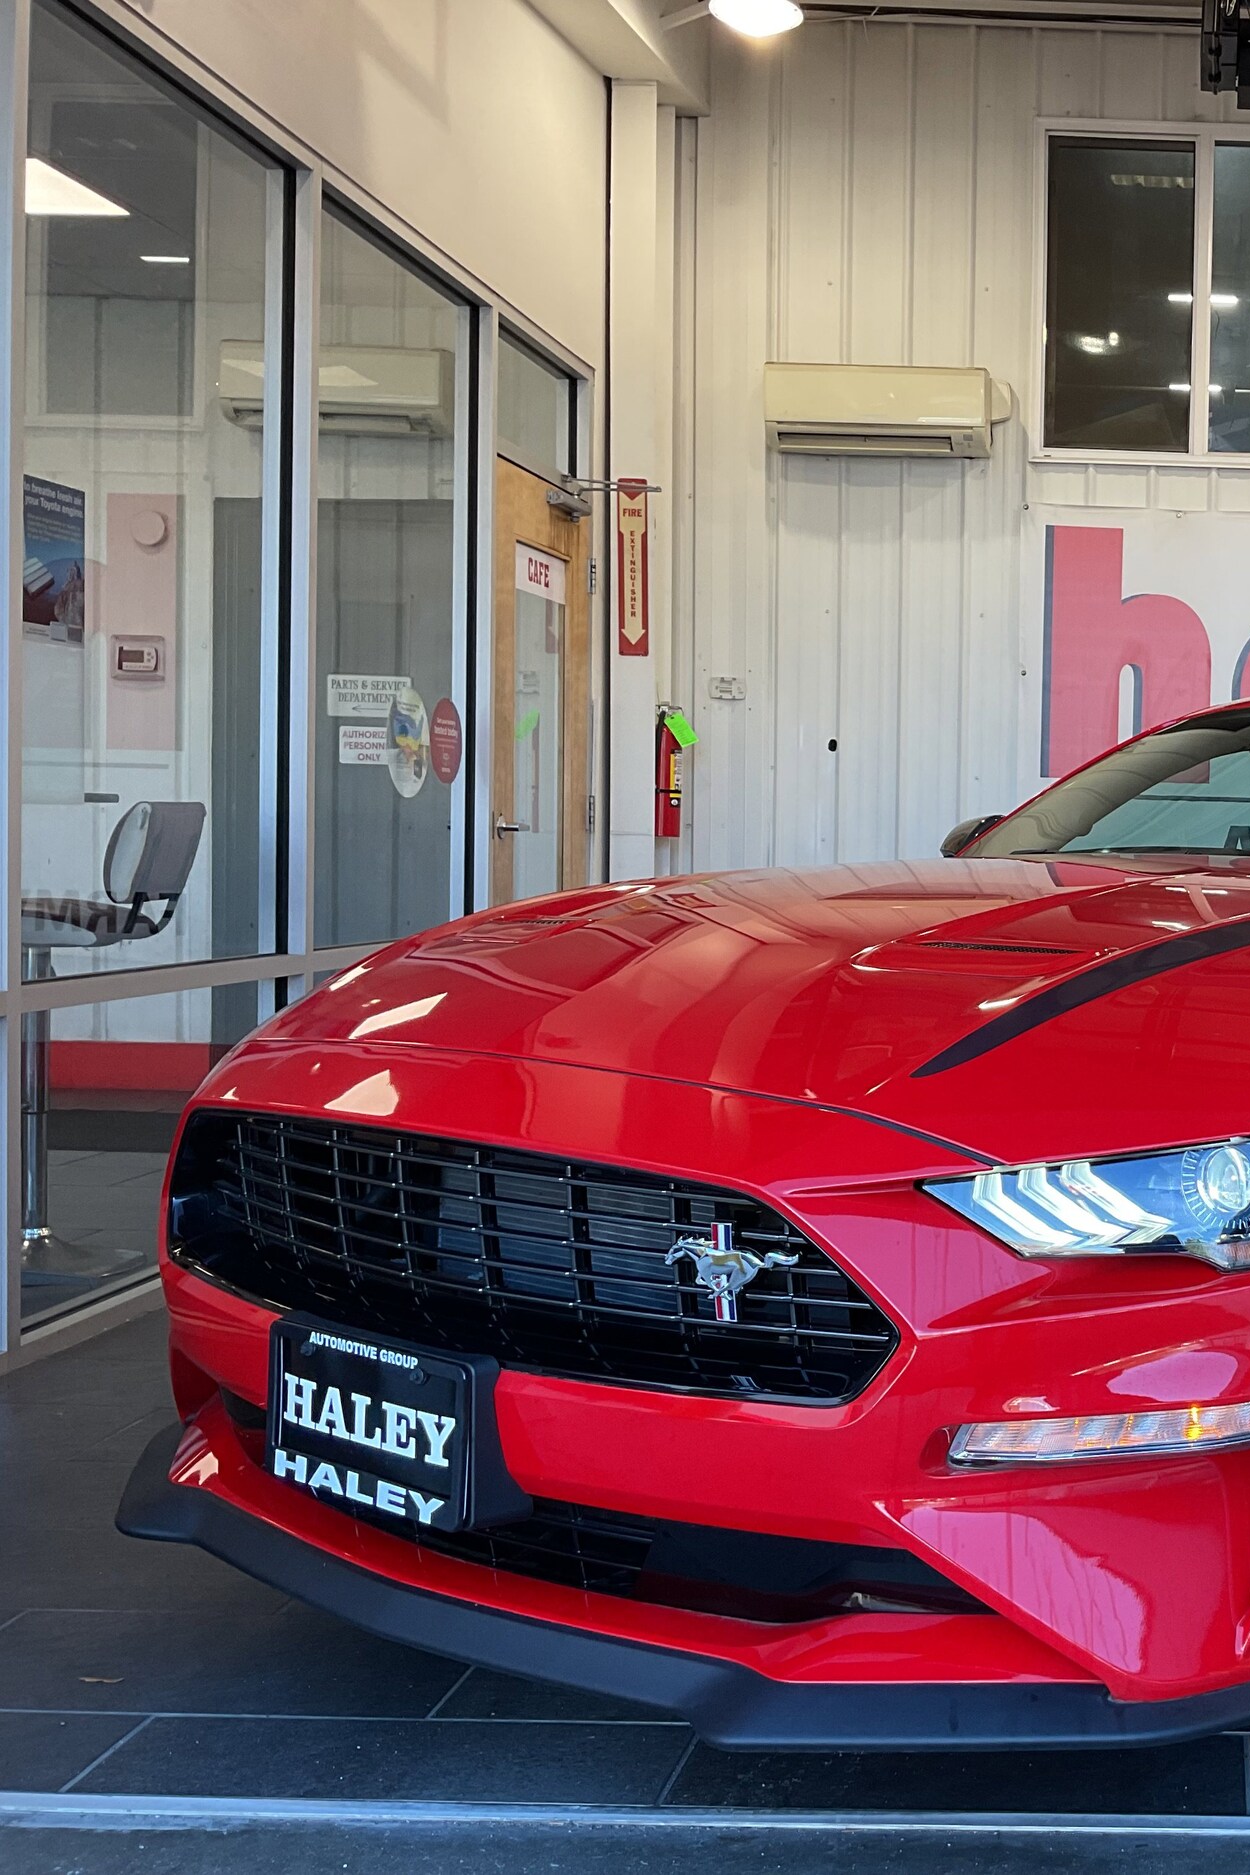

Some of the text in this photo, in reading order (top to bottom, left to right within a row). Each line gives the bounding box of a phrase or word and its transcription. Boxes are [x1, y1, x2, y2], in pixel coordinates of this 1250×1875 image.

[40, 497, 61, 511] Toyota
[622, 508, 643, 518] FIRE
[527, 557, 550, 588] CAFE
[629, 530, 637, 618] EXTINGUISHER
[331, 678, 359, 690] PARTS
[361, 679, 369, 690] &
[342, 730, 386, 739] AUTHORIZ
[343, 741, 386, 750] PERSONN
[357, 752, 381, 761] ONLY
[309, 1331, 419, 1370] AUTOMOTIVE GROUP
[283, 1371, 456, 1468] HALEY
[273, 1448, 445, 1525] HALEY
